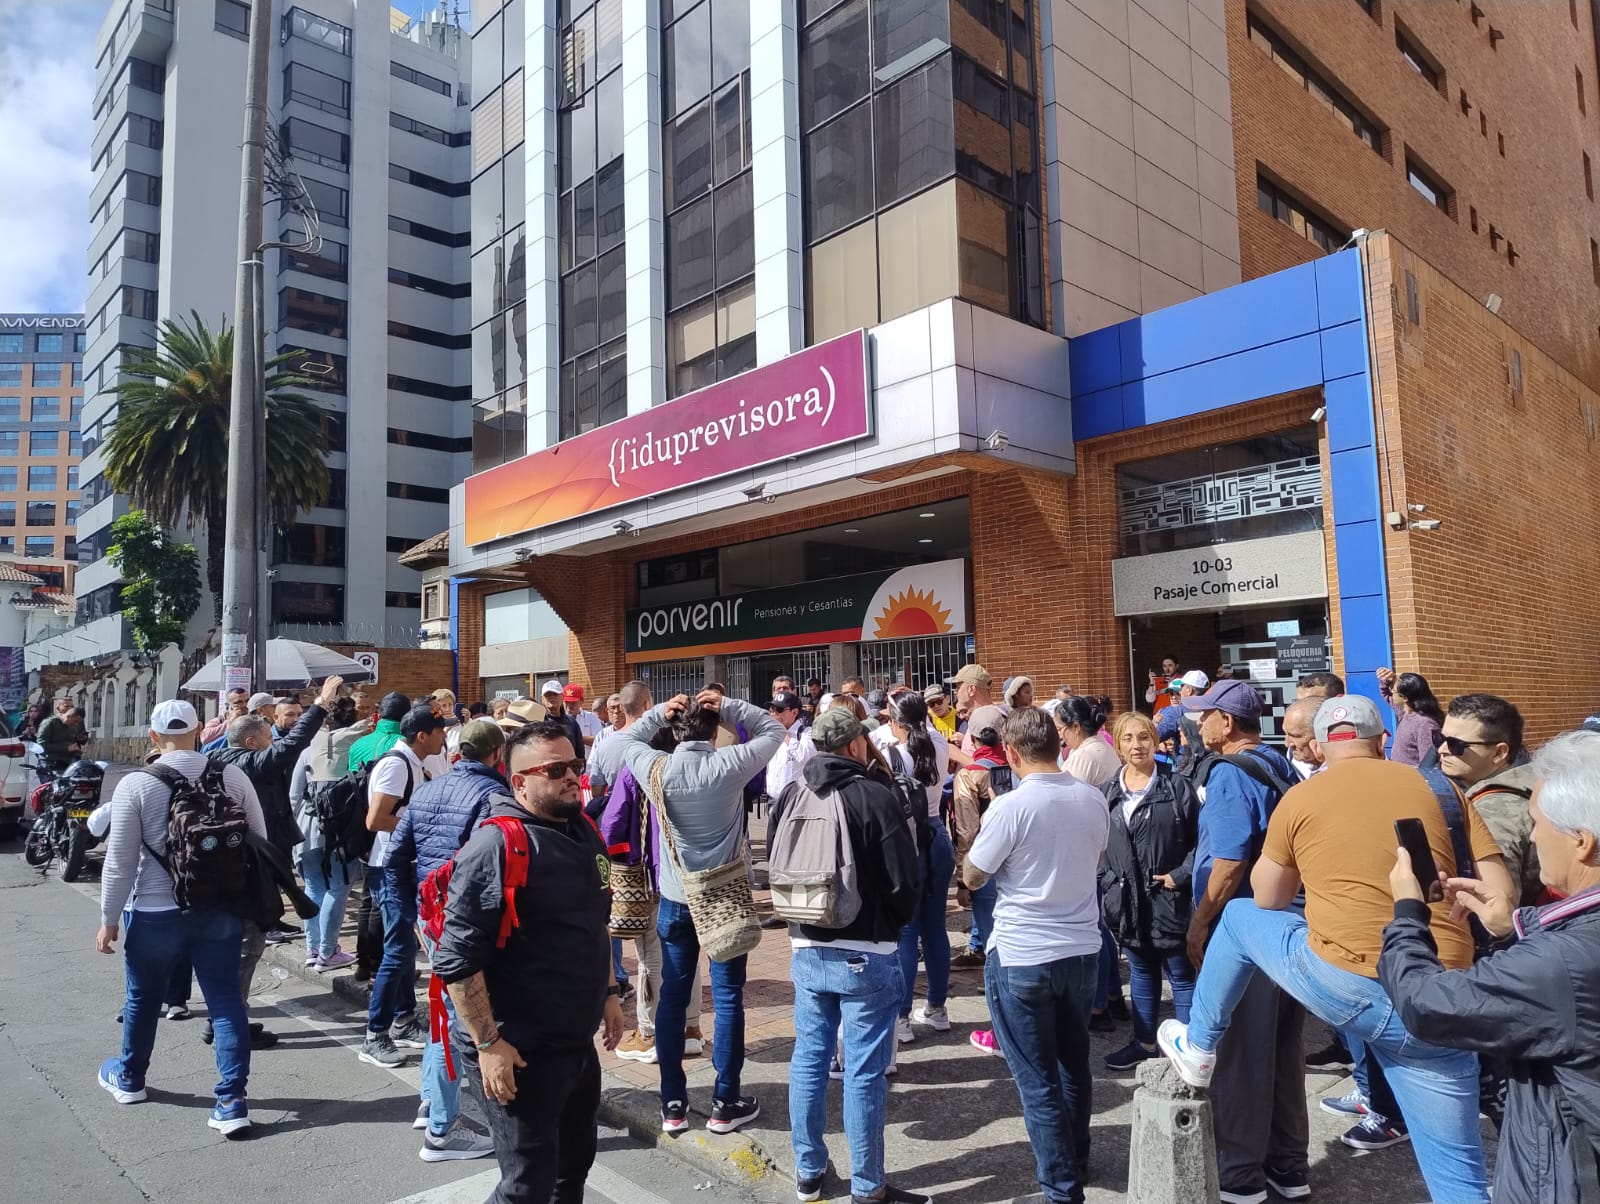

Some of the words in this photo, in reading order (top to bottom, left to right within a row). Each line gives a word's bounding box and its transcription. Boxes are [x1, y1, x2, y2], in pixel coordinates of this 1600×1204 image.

[1192, 557, 1233, 575] 10-03
[1153, 583, 1198, 601] Pasaje
[1201, 573, 1279, 595] Comercial
[754, 605, 797, 619] Pensiones
[799, 604, 805, 616] y
[808, 597, 853, 612] Cesantías
[637, 597, 743, 648] porvenir
